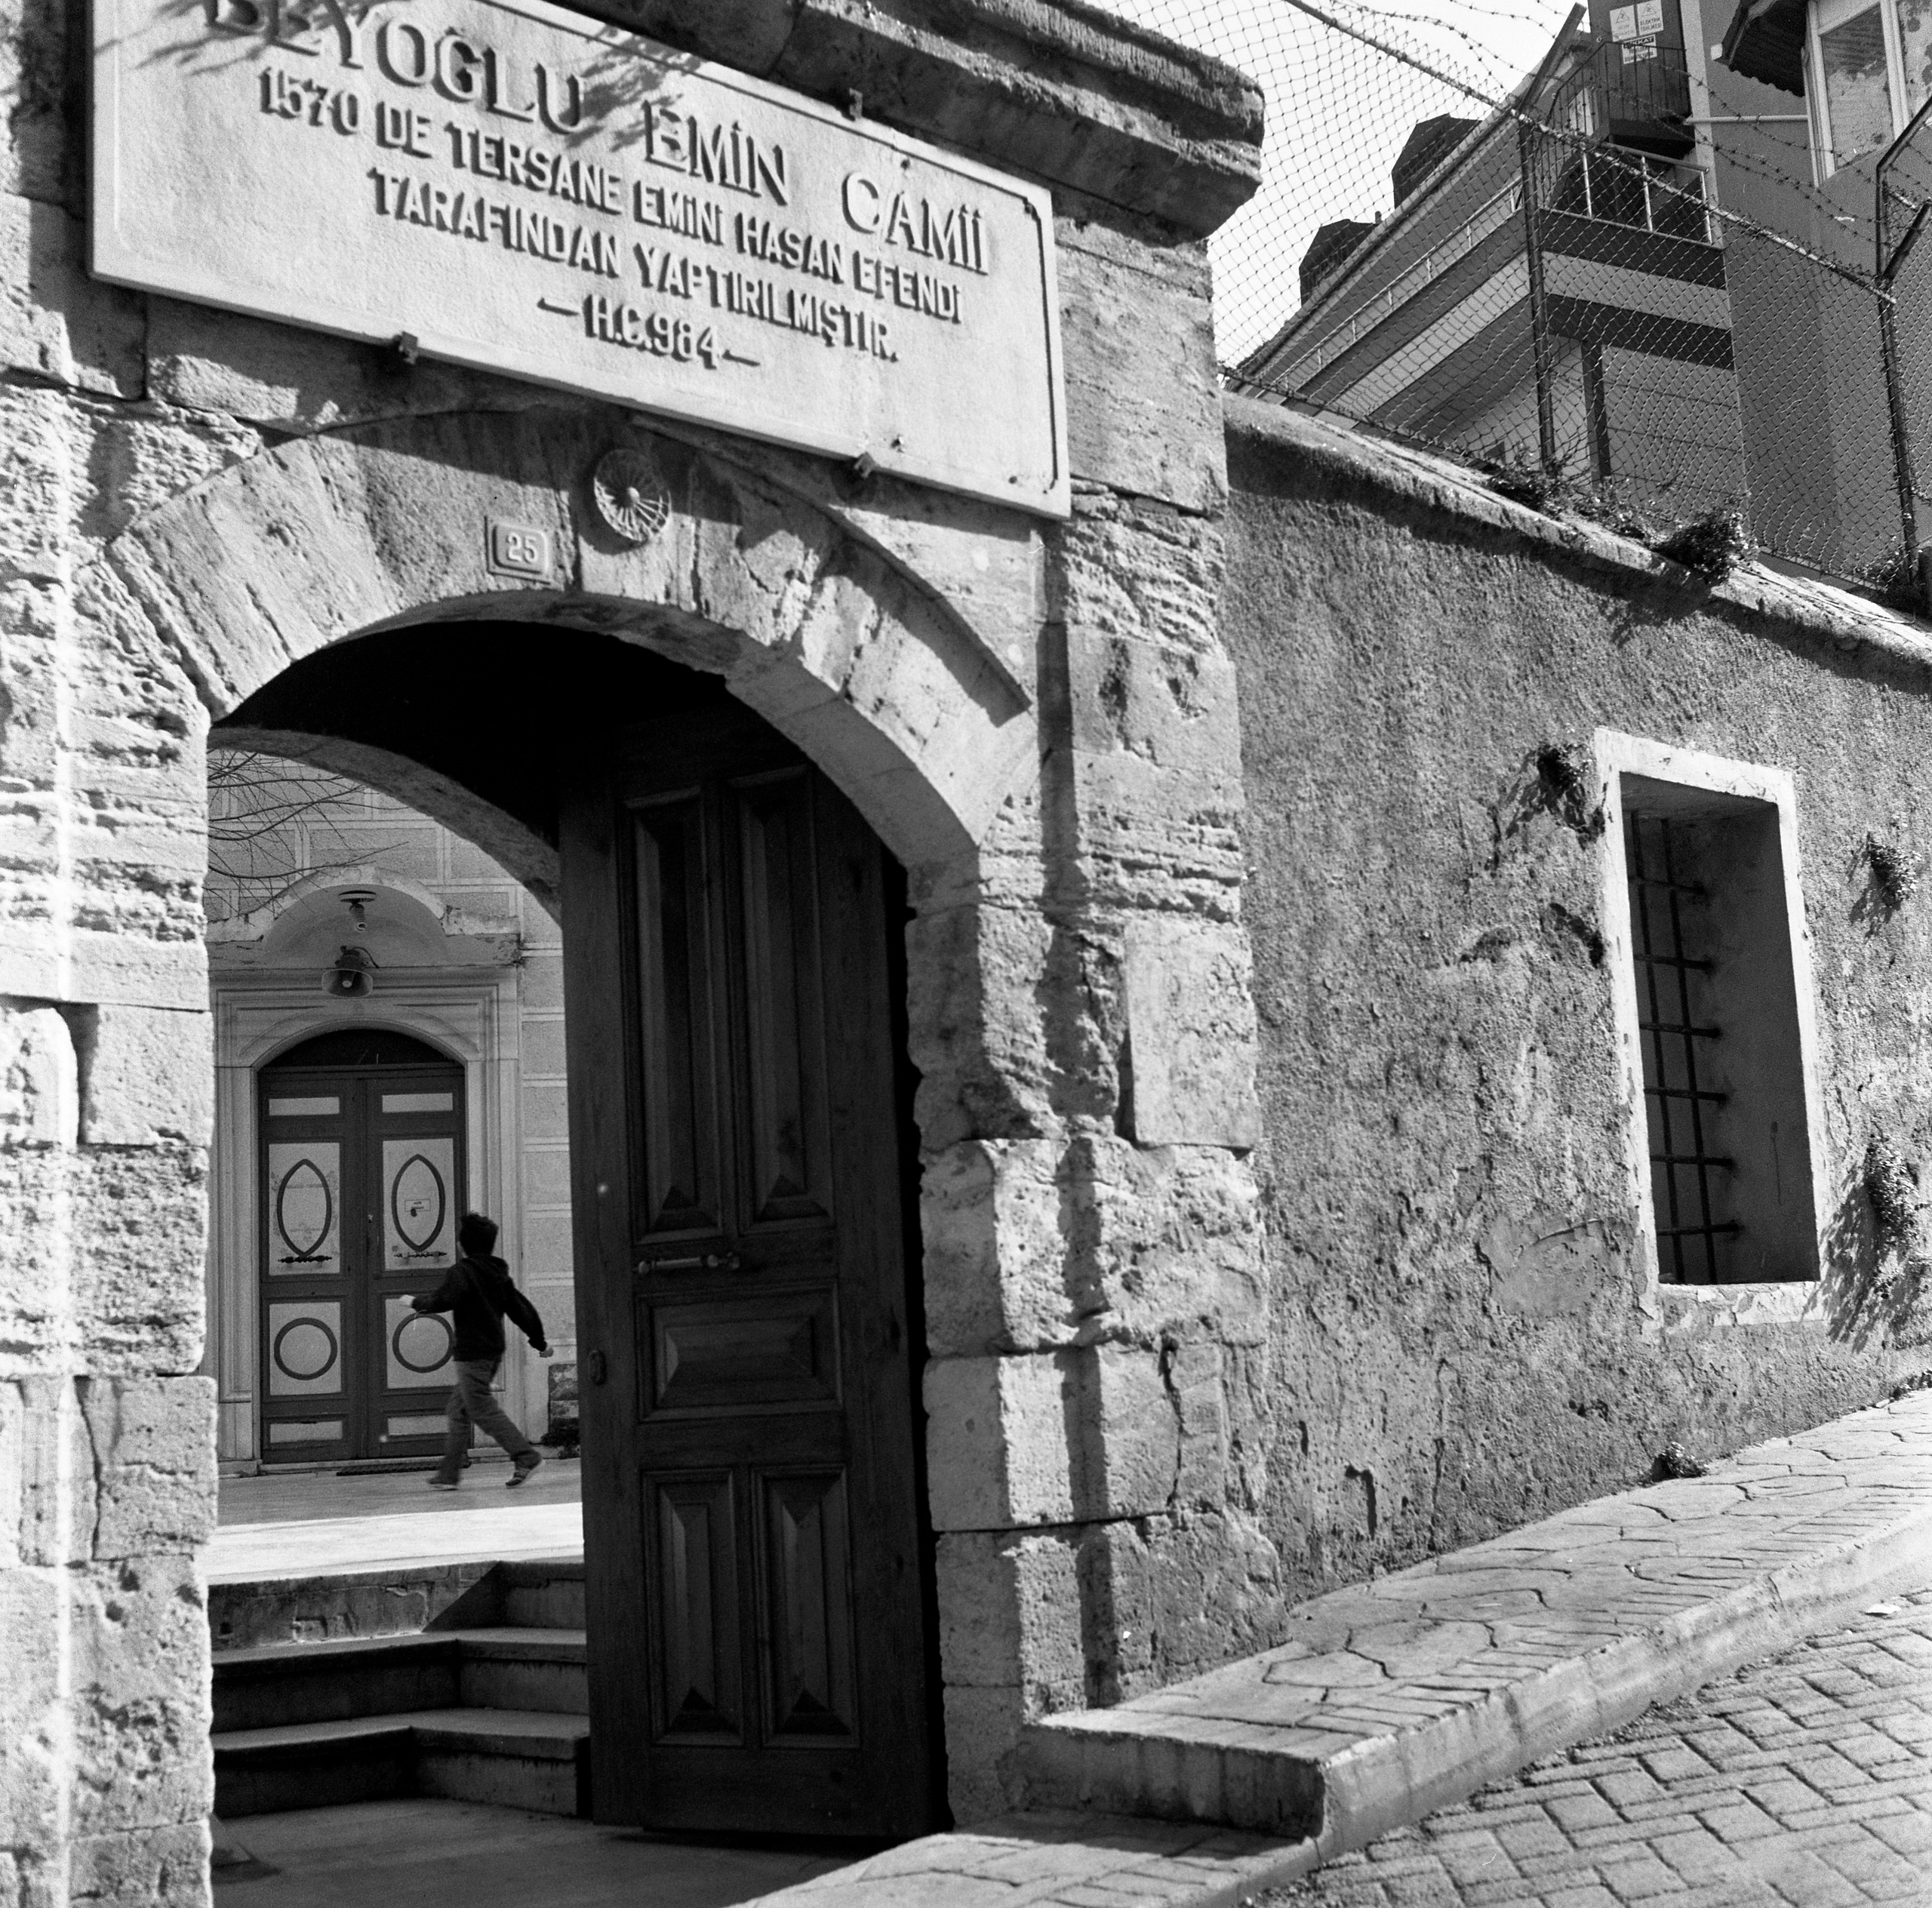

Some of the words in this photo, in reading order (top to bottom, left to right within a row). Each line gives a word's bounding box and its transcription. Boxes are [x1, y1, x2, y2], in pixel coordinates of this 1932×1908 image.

[260, 66, 362, 137] 1570
[376, 100, 433, 159] DE
[445, 121, 623, 215] TERSANE
[734, 211, 844, 285] HASAN
[367, 167, 621, 279] TARAFINDAN
[641, 99, 789, 206] EMİN
[841, 171, 989, 276] CAMİİ
[507, 532, 538, 564] 25
